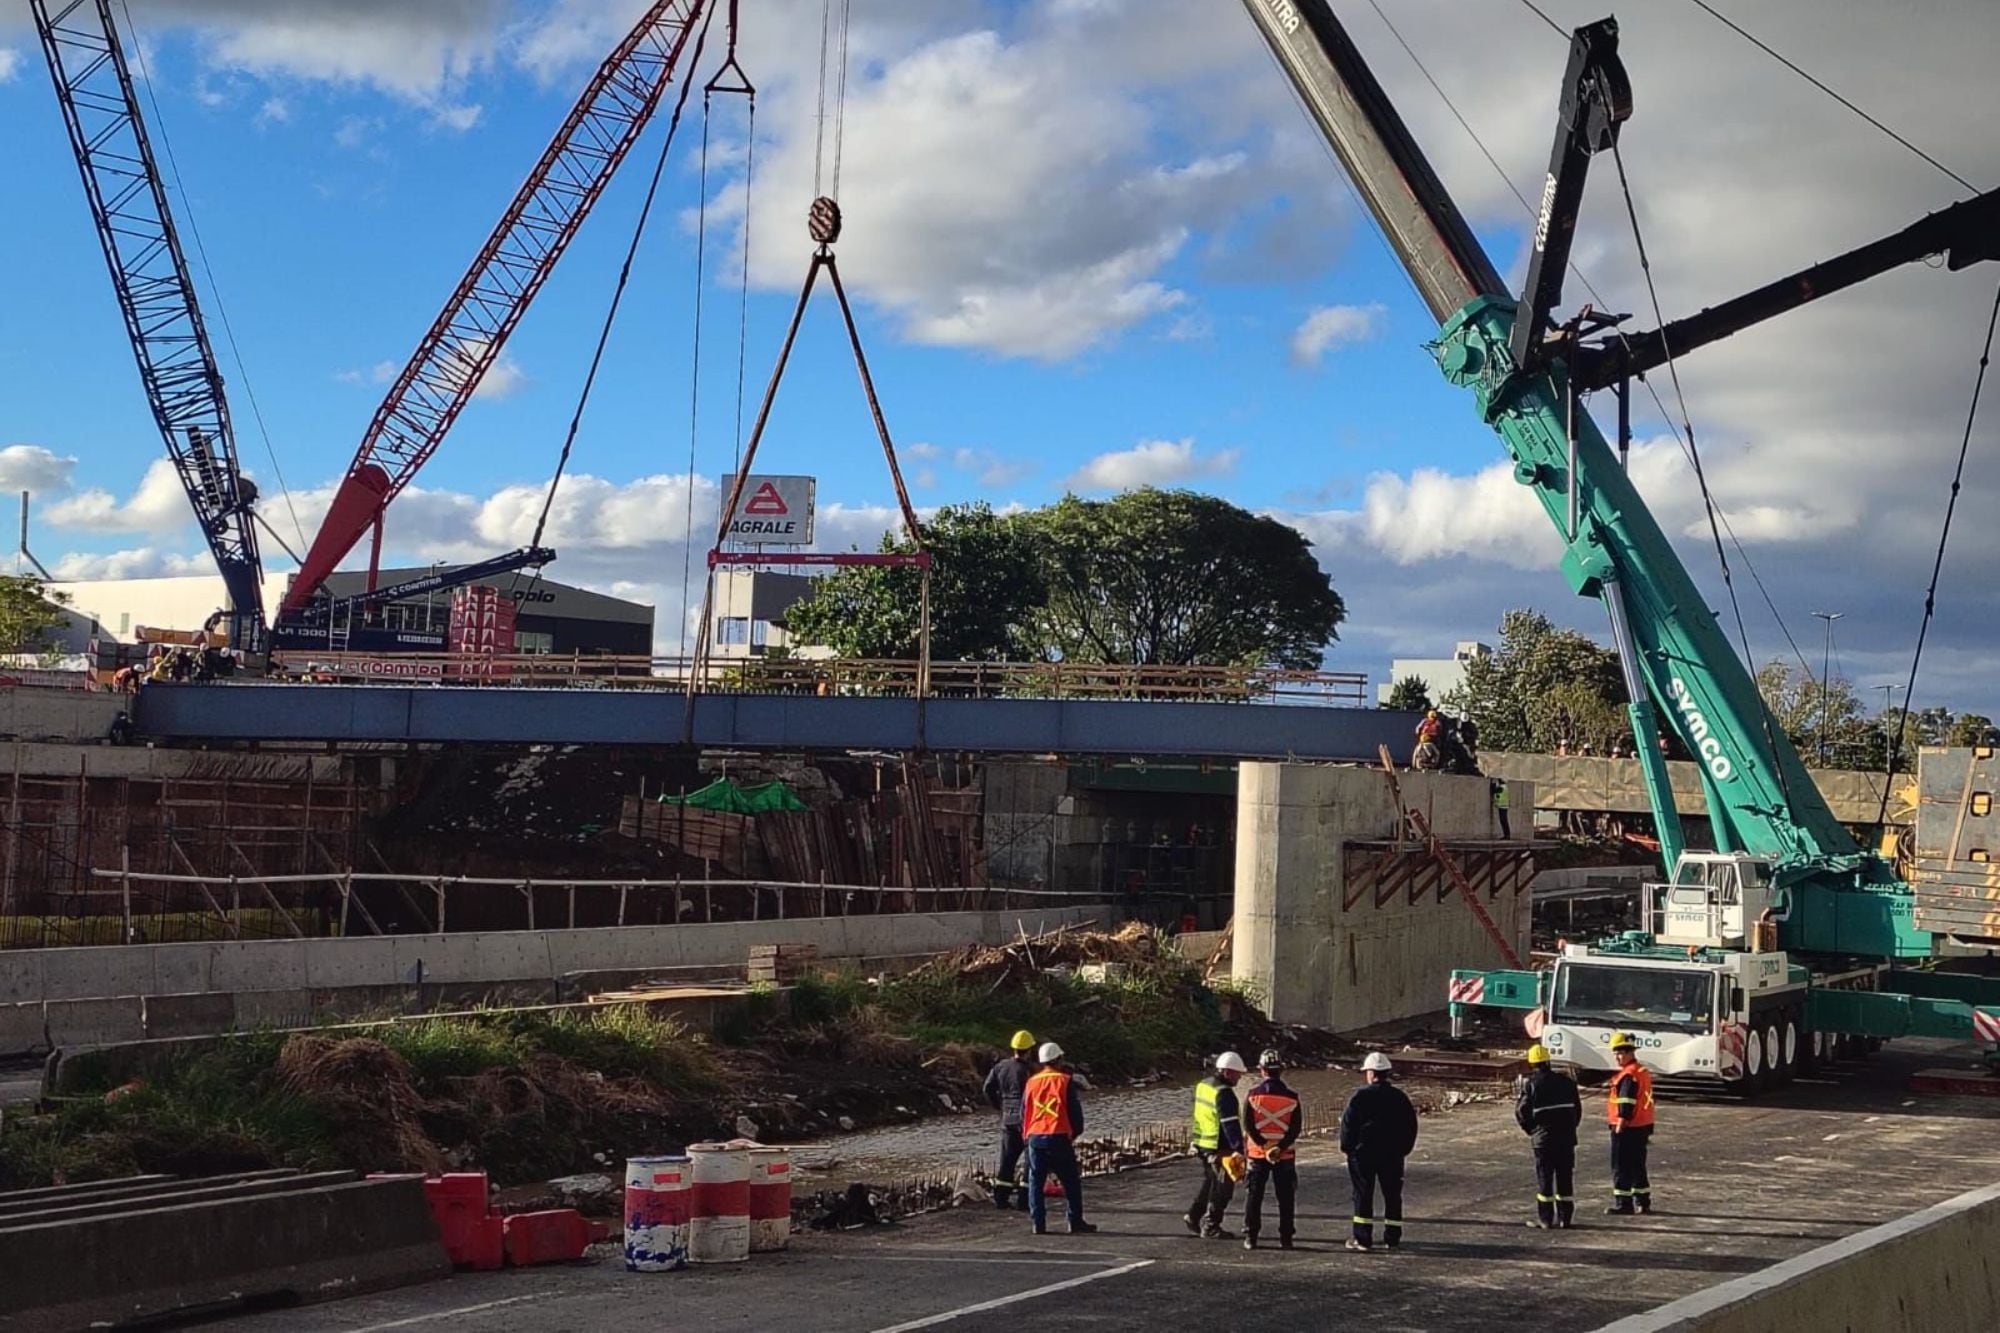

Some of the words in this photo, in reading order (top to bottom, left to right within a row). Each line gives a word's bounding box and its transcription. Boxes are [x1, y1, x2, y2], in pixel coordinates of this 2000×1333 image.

[729, 521, 796, 534] AGRALE
[399, 576, 443, 593] COAMTRA
[359, 662, 442, 675] COAMTRA
[1665, 678, 1731, 780] SYMCO
